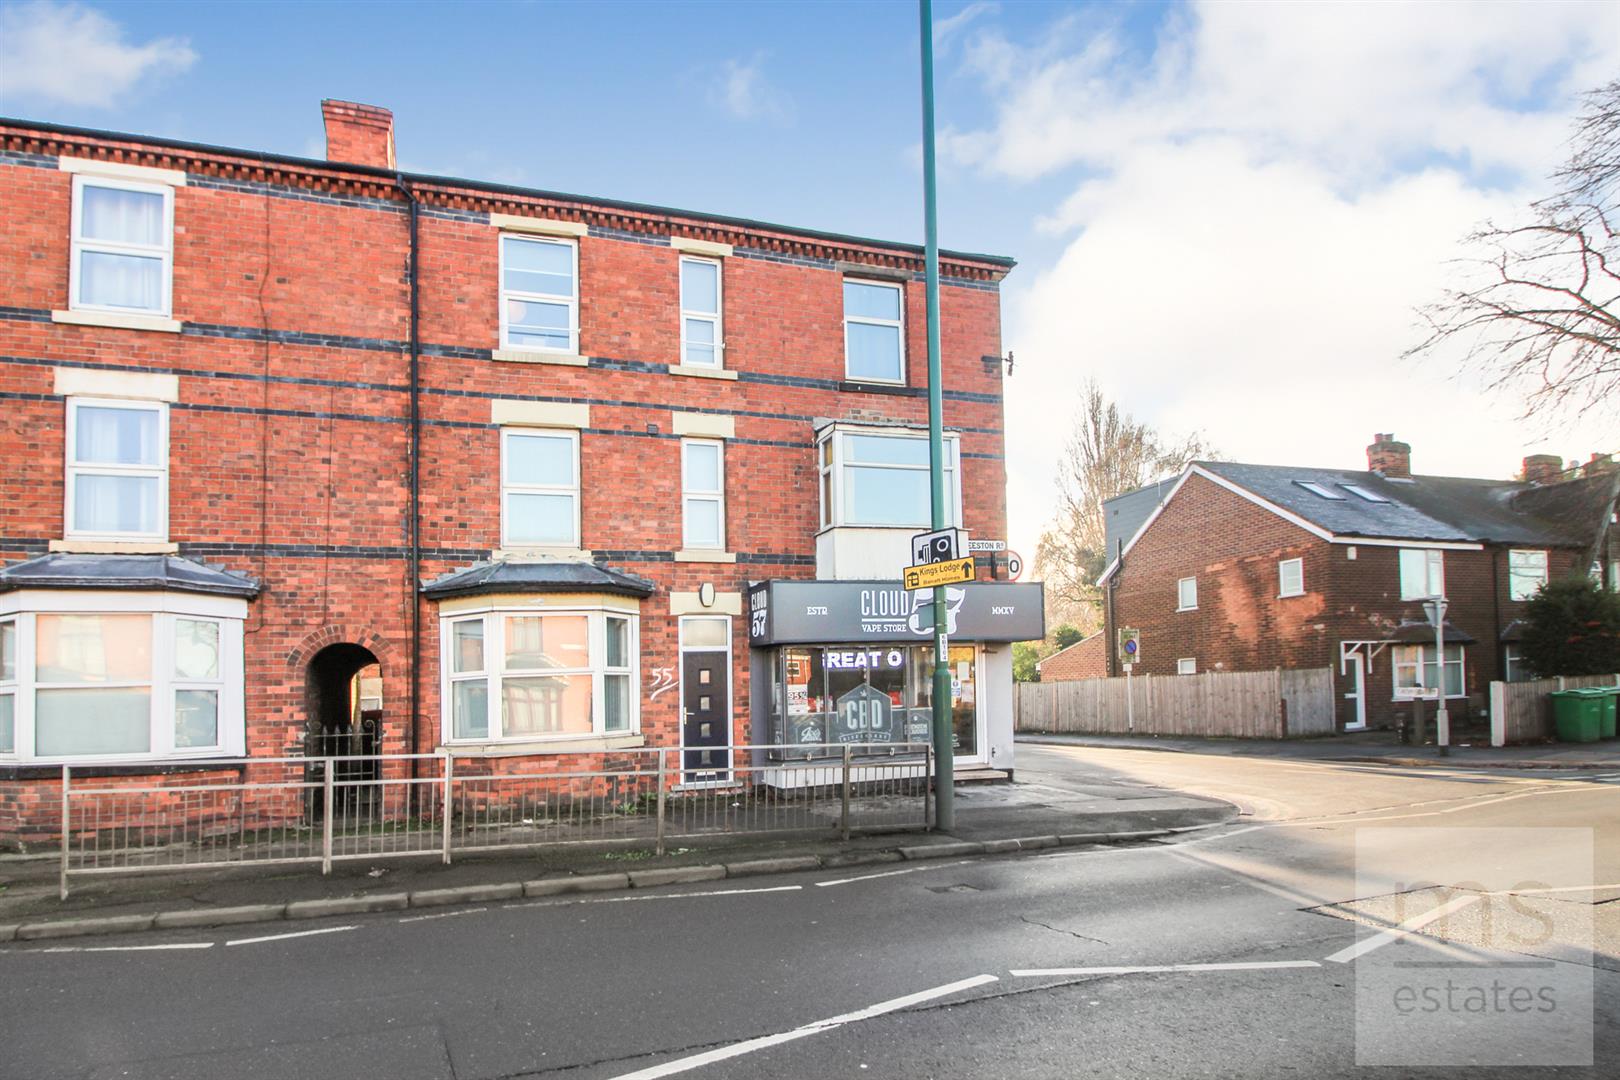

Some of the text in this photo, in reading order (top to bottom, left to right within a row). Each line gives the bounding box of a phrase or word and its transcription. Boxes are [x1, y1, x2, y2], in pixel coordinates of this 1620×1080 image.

[968, 541, 994, 550] EESTON
[919, 563, 960, 576] Kings Lodge
[751, 590, 767, 611] CLOUD
[861, 587, 965, 635] CLOUD 57
[752, 609, 767, 637] 57
[861, 623, 907, 633] VAPE STORE
[650, 664, 676, 687] 55
[847, 700, 882, 729] CBD
